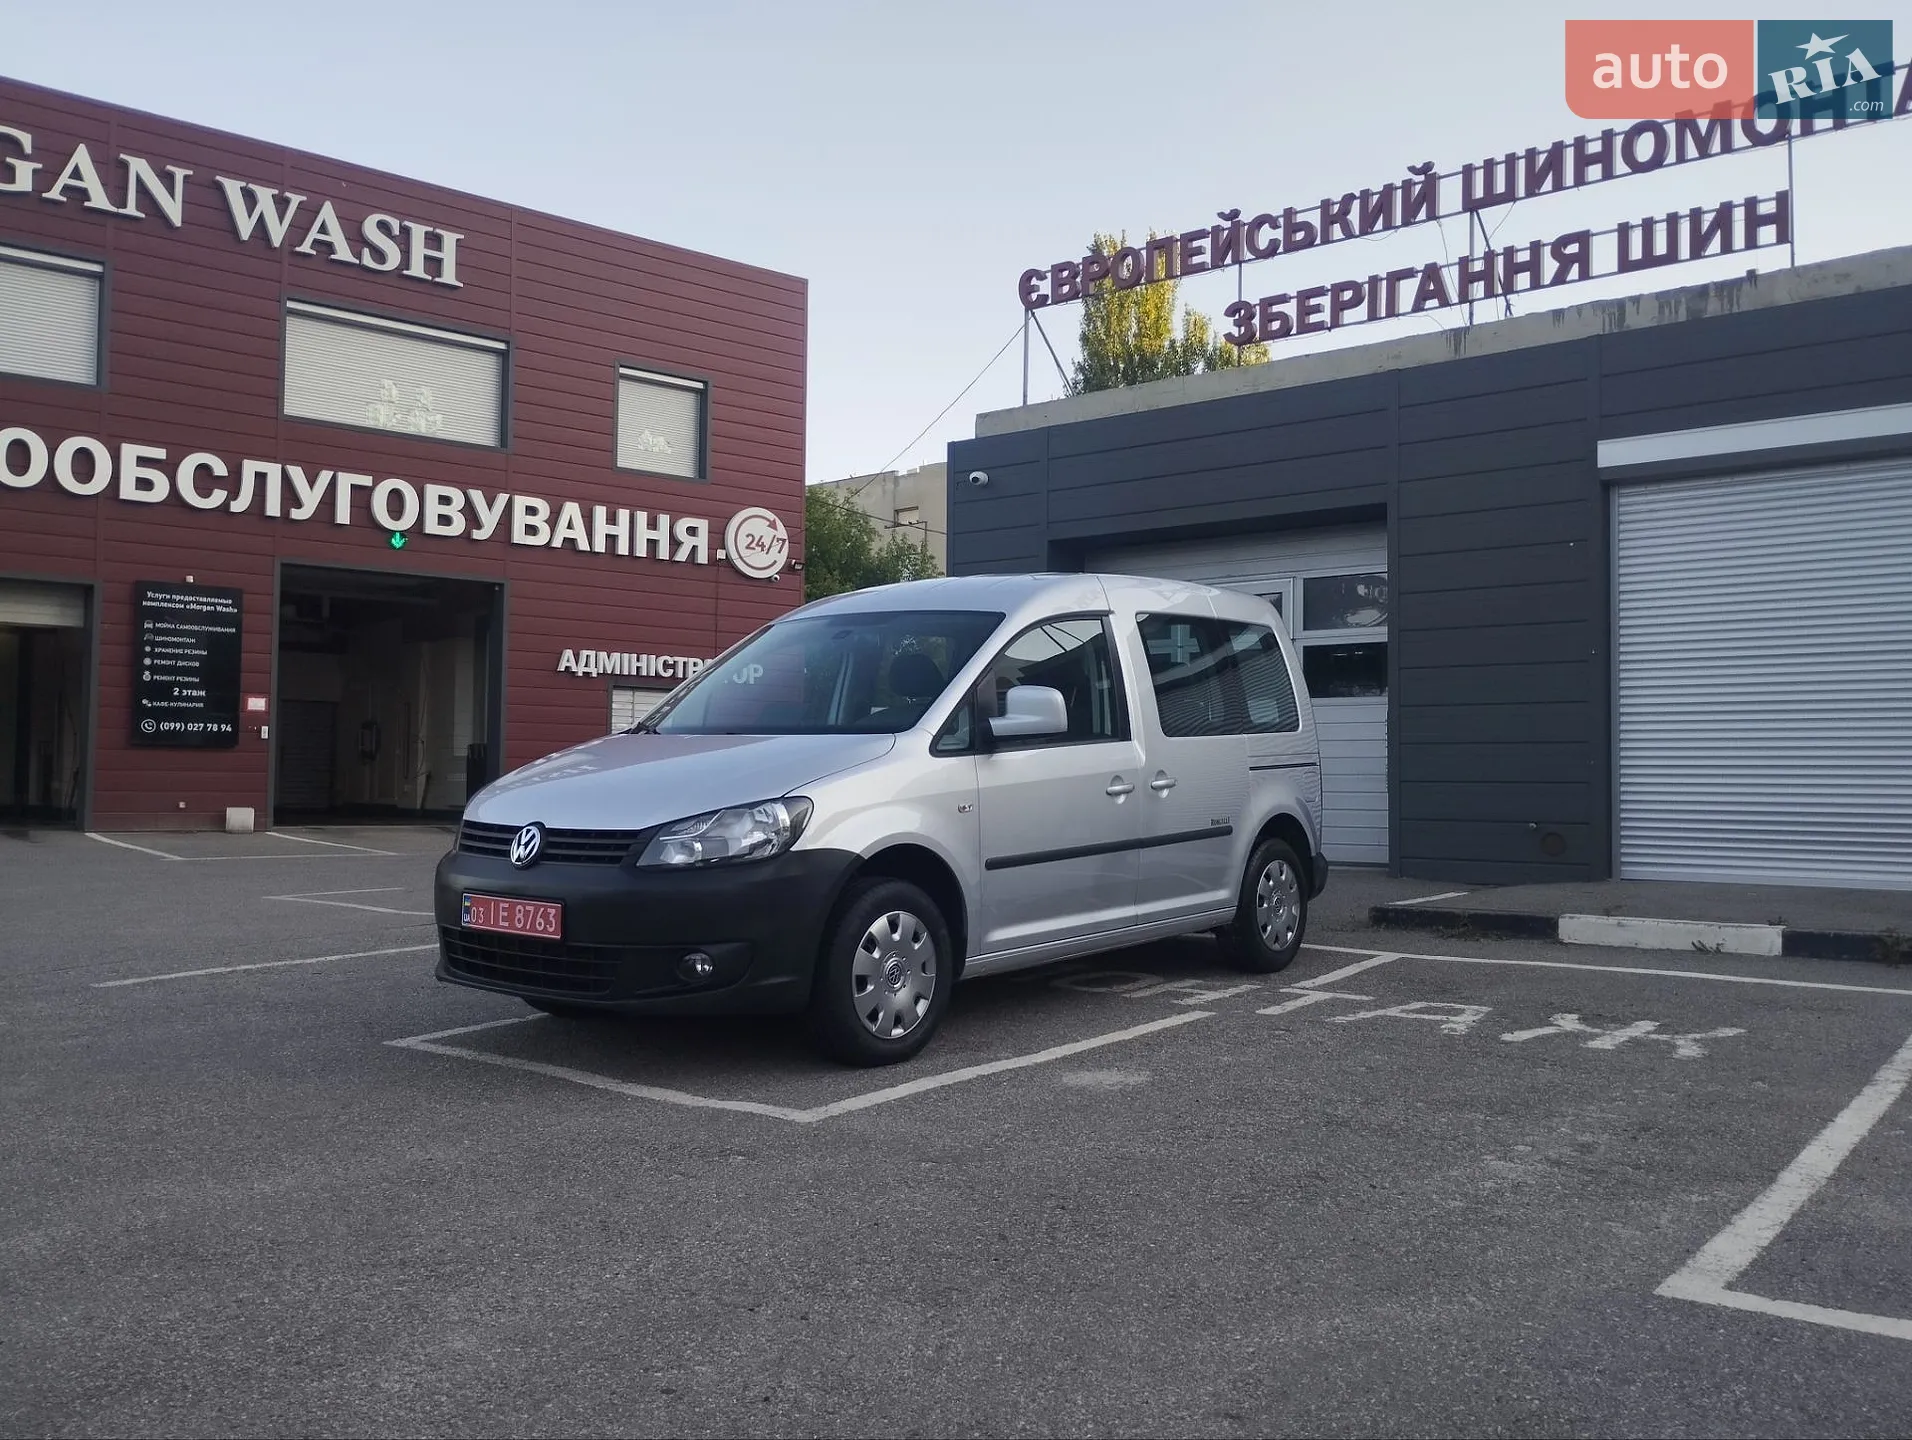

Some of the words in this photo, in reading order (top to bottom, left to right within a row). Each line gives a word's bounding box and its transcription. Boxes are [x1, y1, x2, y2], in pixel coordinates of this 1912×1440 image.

[0, 125, 194, 228] GAN
[215, 174, 465, 288] WASH
[1018, 161, 1441, 308] ЄВРОПЕЙСЬКИЙ
[1223, 229, 1593, 347] ЗБЕРІГАННЯ
[1616, 189, 1792, 269] ШИН
[0, 426, 709, 565] ООБСЛУГОВУВАННЯ
[744, 533, 787, 555] 24/7
[147, 591, 170, 600] Услуги
[173, 687, 180, 696] 2
[182, 689, 206, 697] этаж
[160, 721, 185, 731] (099)
[187, 723, 204, 731] 027
[207, 723, 218, 732] 78
[220, 724, 232, 732] 94
[471, 906, 484, 924] 03
[515, 905, 556, 932] 8763
